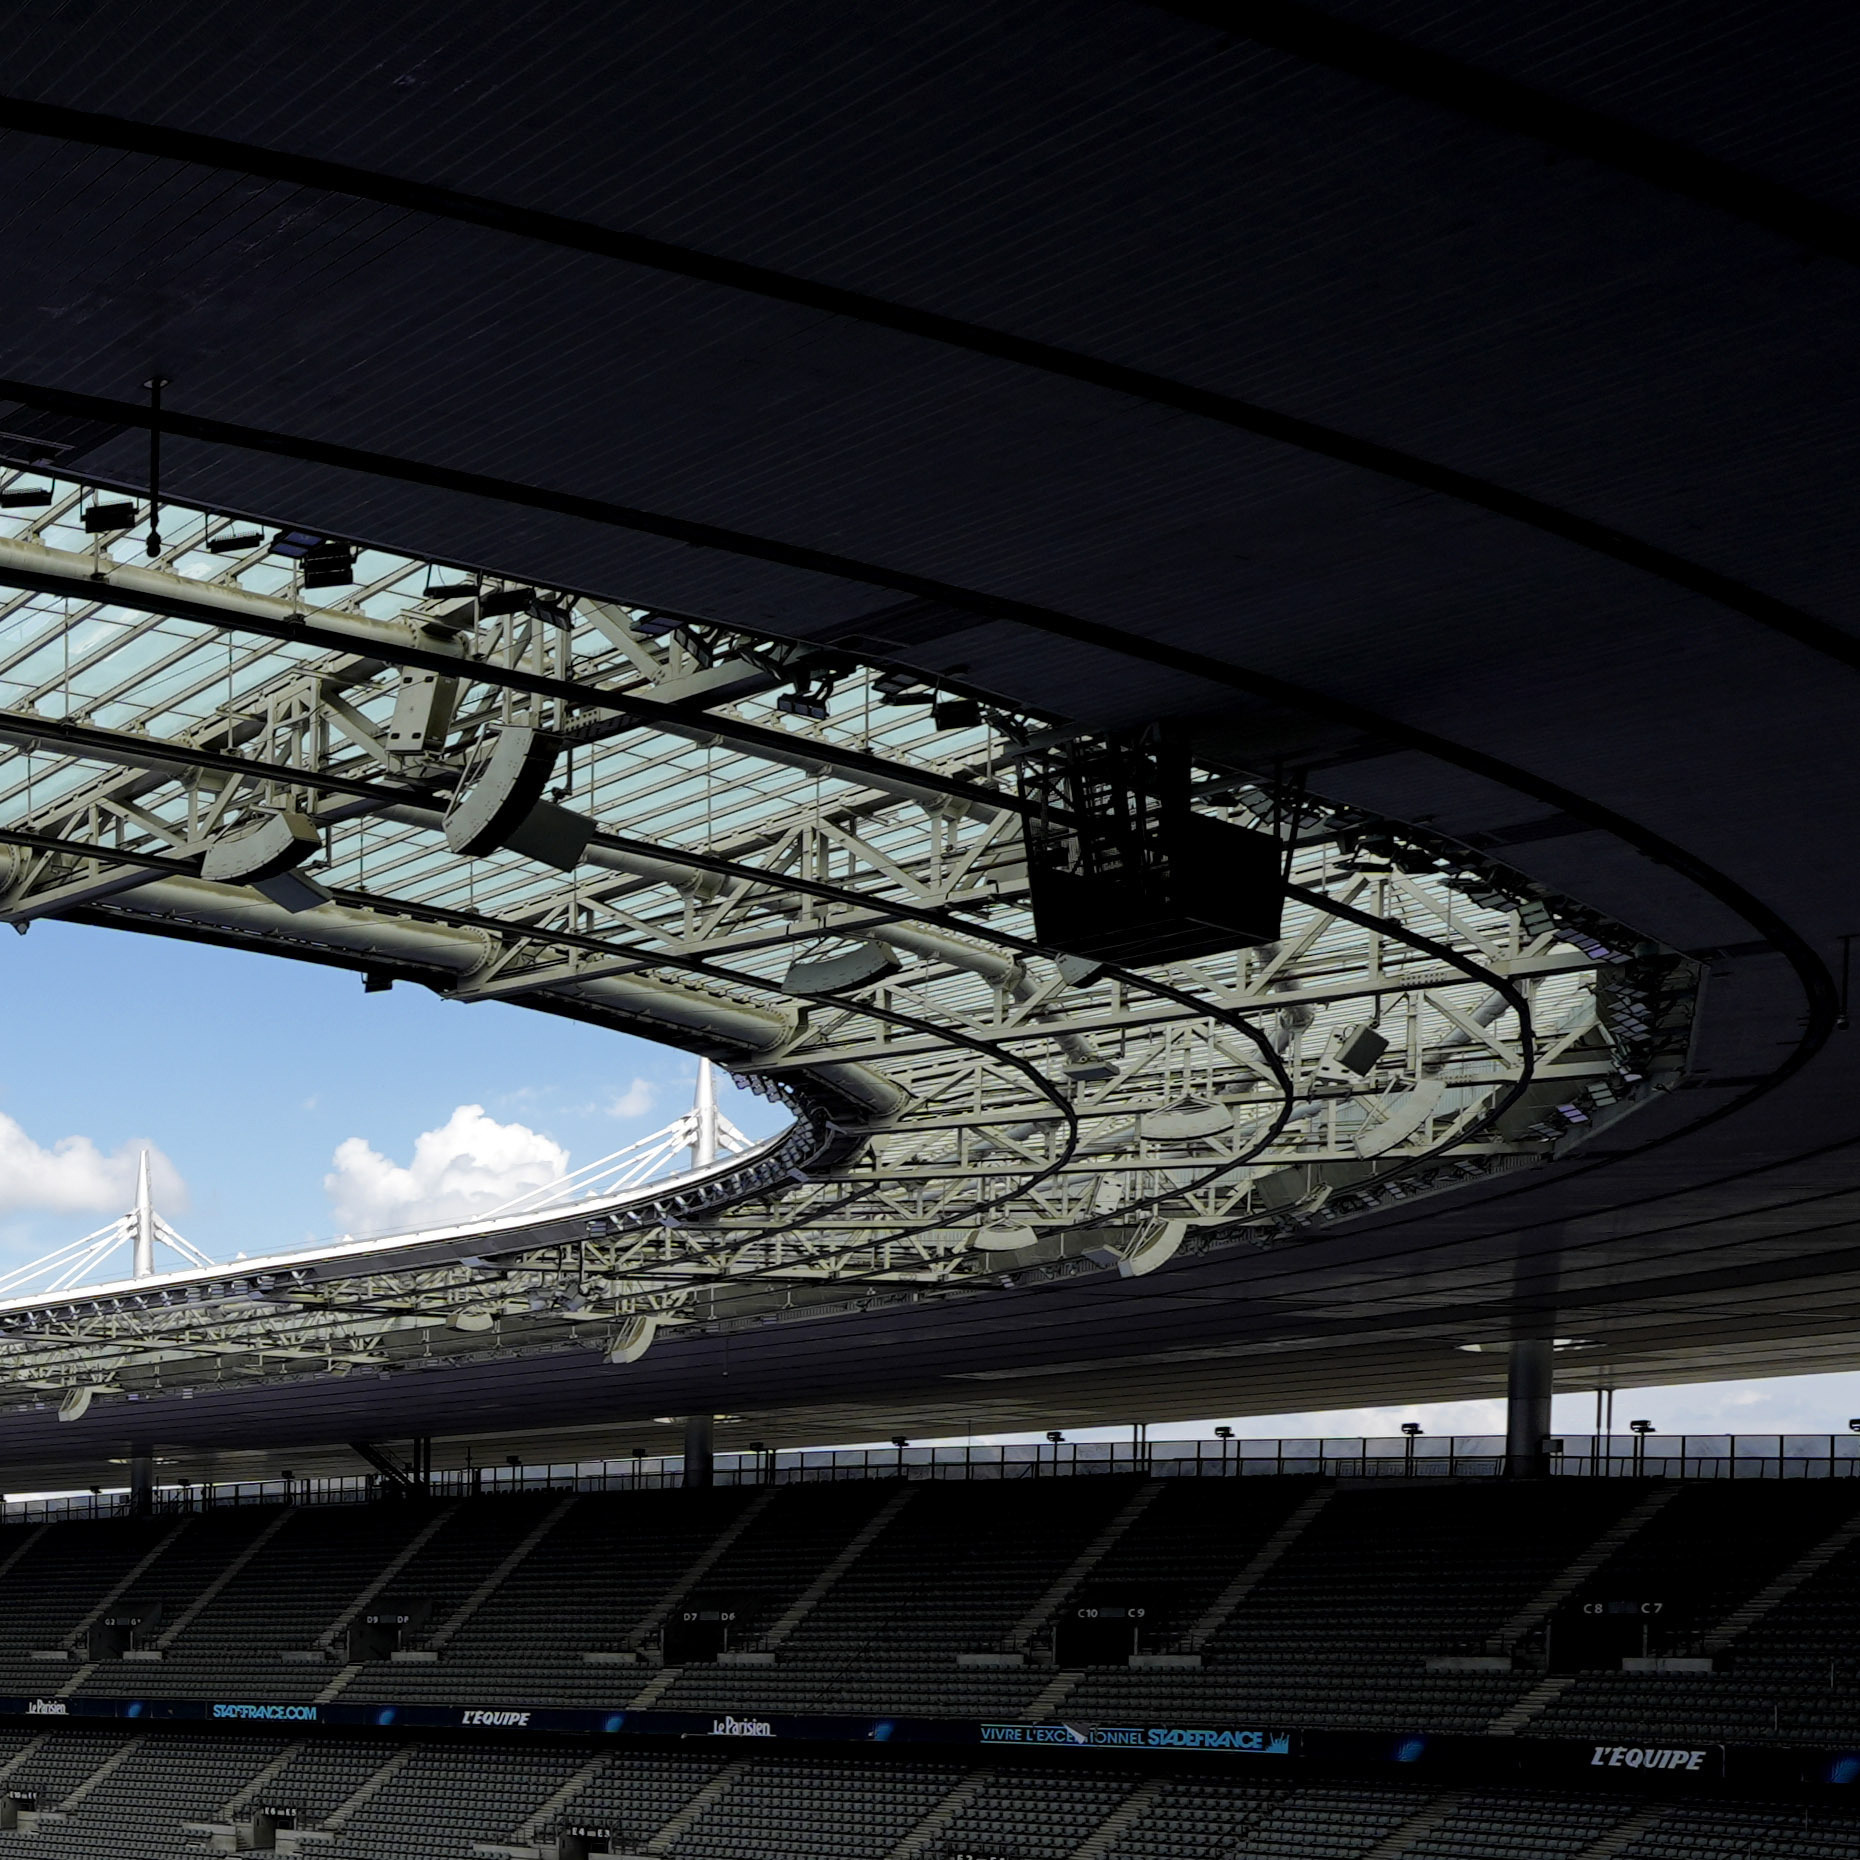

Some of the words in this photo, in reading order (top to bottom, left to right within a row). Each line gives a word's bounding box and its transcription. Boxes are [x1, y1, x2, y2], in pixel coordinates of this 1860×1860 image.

[1077, 1608, 1098, 1619] C10
[1127, 1608, 1146, 1618] C9
[1583, 1603, 1603, 1614] C8
[1640, 1603, 1664, 1614] C7
[683, 1612, 698, 1621] D7
[36, 1699, 66, 1713] Parisien
[712, 1720, 725, 1735] Le
[724, 1715, 771, 1735] Parisien
[980, 1727, 1022, 1741] VIVRE
[1026, 1729, 1145, 1745] L'EXCEIONNEL
[1147, 1728, 1265, 1749] STADEFRANCE
